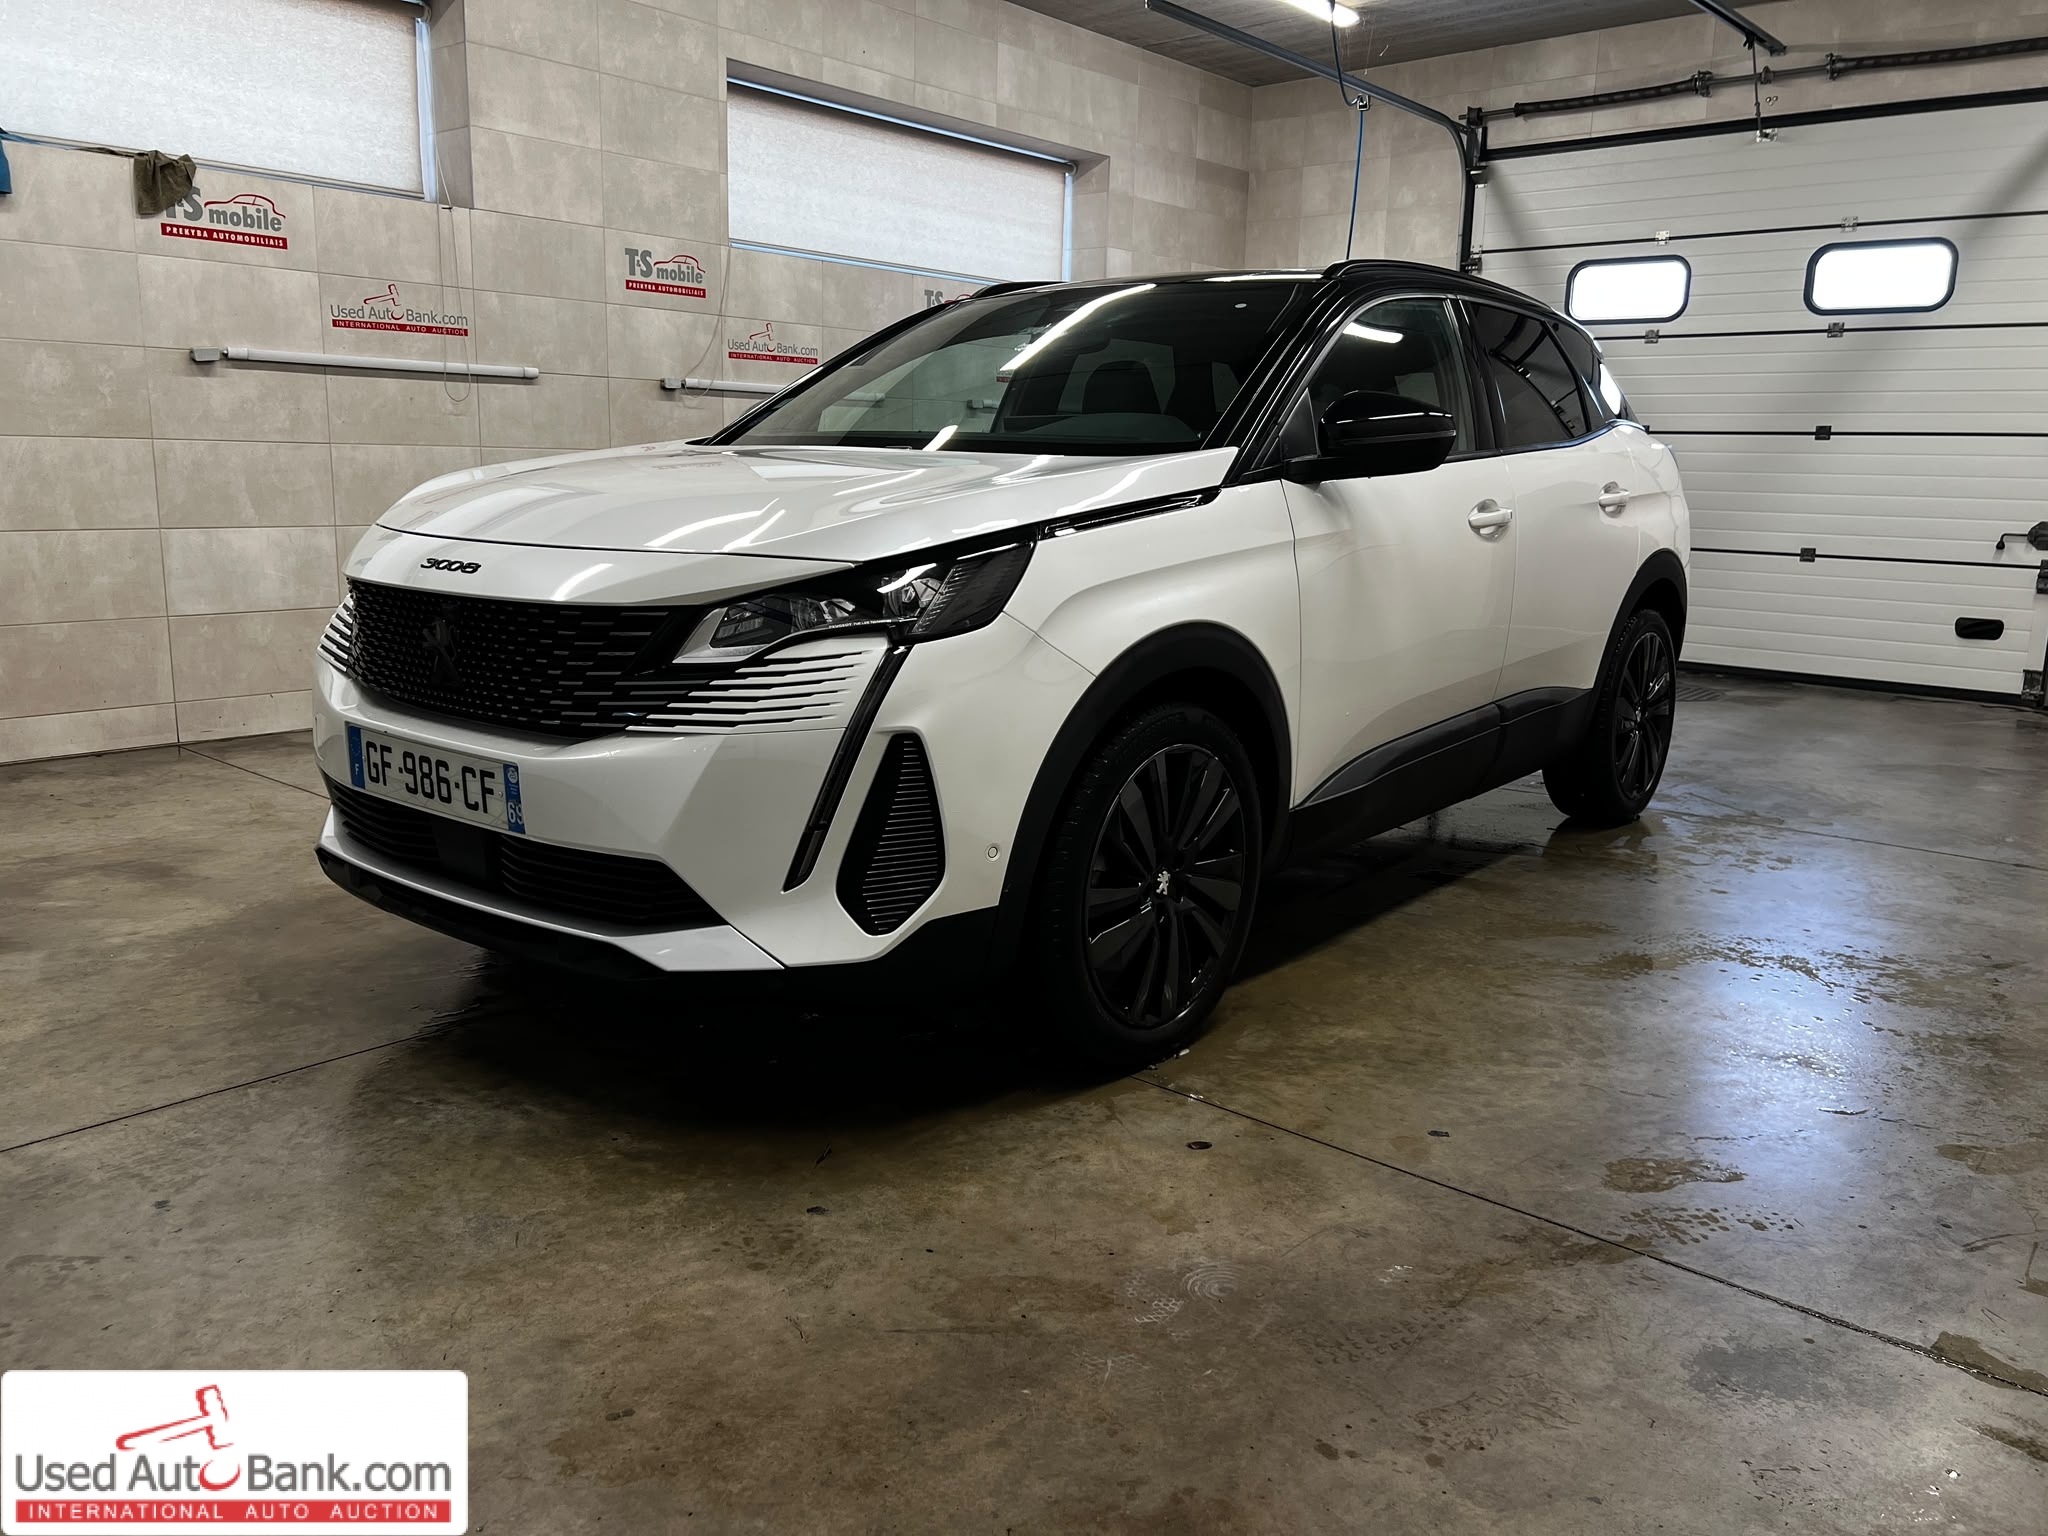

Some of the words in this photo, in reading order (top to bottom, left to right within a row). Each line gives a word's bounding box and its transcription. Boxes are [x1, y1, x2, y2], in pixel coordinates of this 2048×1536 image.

[208, 206, 282, 232] mobile
[166, 226, 208, 238] PREKYBA
[212, 231, 284, 247] AUTOMOBILIAIS
[625, 247, 653, 278] T&S
[656, 264, 703, 284] mobile
[628, 281, 656, 291] PREKYBA
[330, 304, 365, 319] Used
[405, 308, 468, 326] Bank.com
[336, 320, 400, 331] INTERNATIONAL
[406, 325, 427, 333] AUTO
[432, 326, 465, 336] AUCTION
[727, 338, 751, 351] Used
[776, 342, 818, 356] Bank.com
[730, 352, 772, 361] INTERNATIONAL
[420, 558, 481, 574] 3008
[354, 763, 360, 776] F
[507, 802, 525, 824] 69
